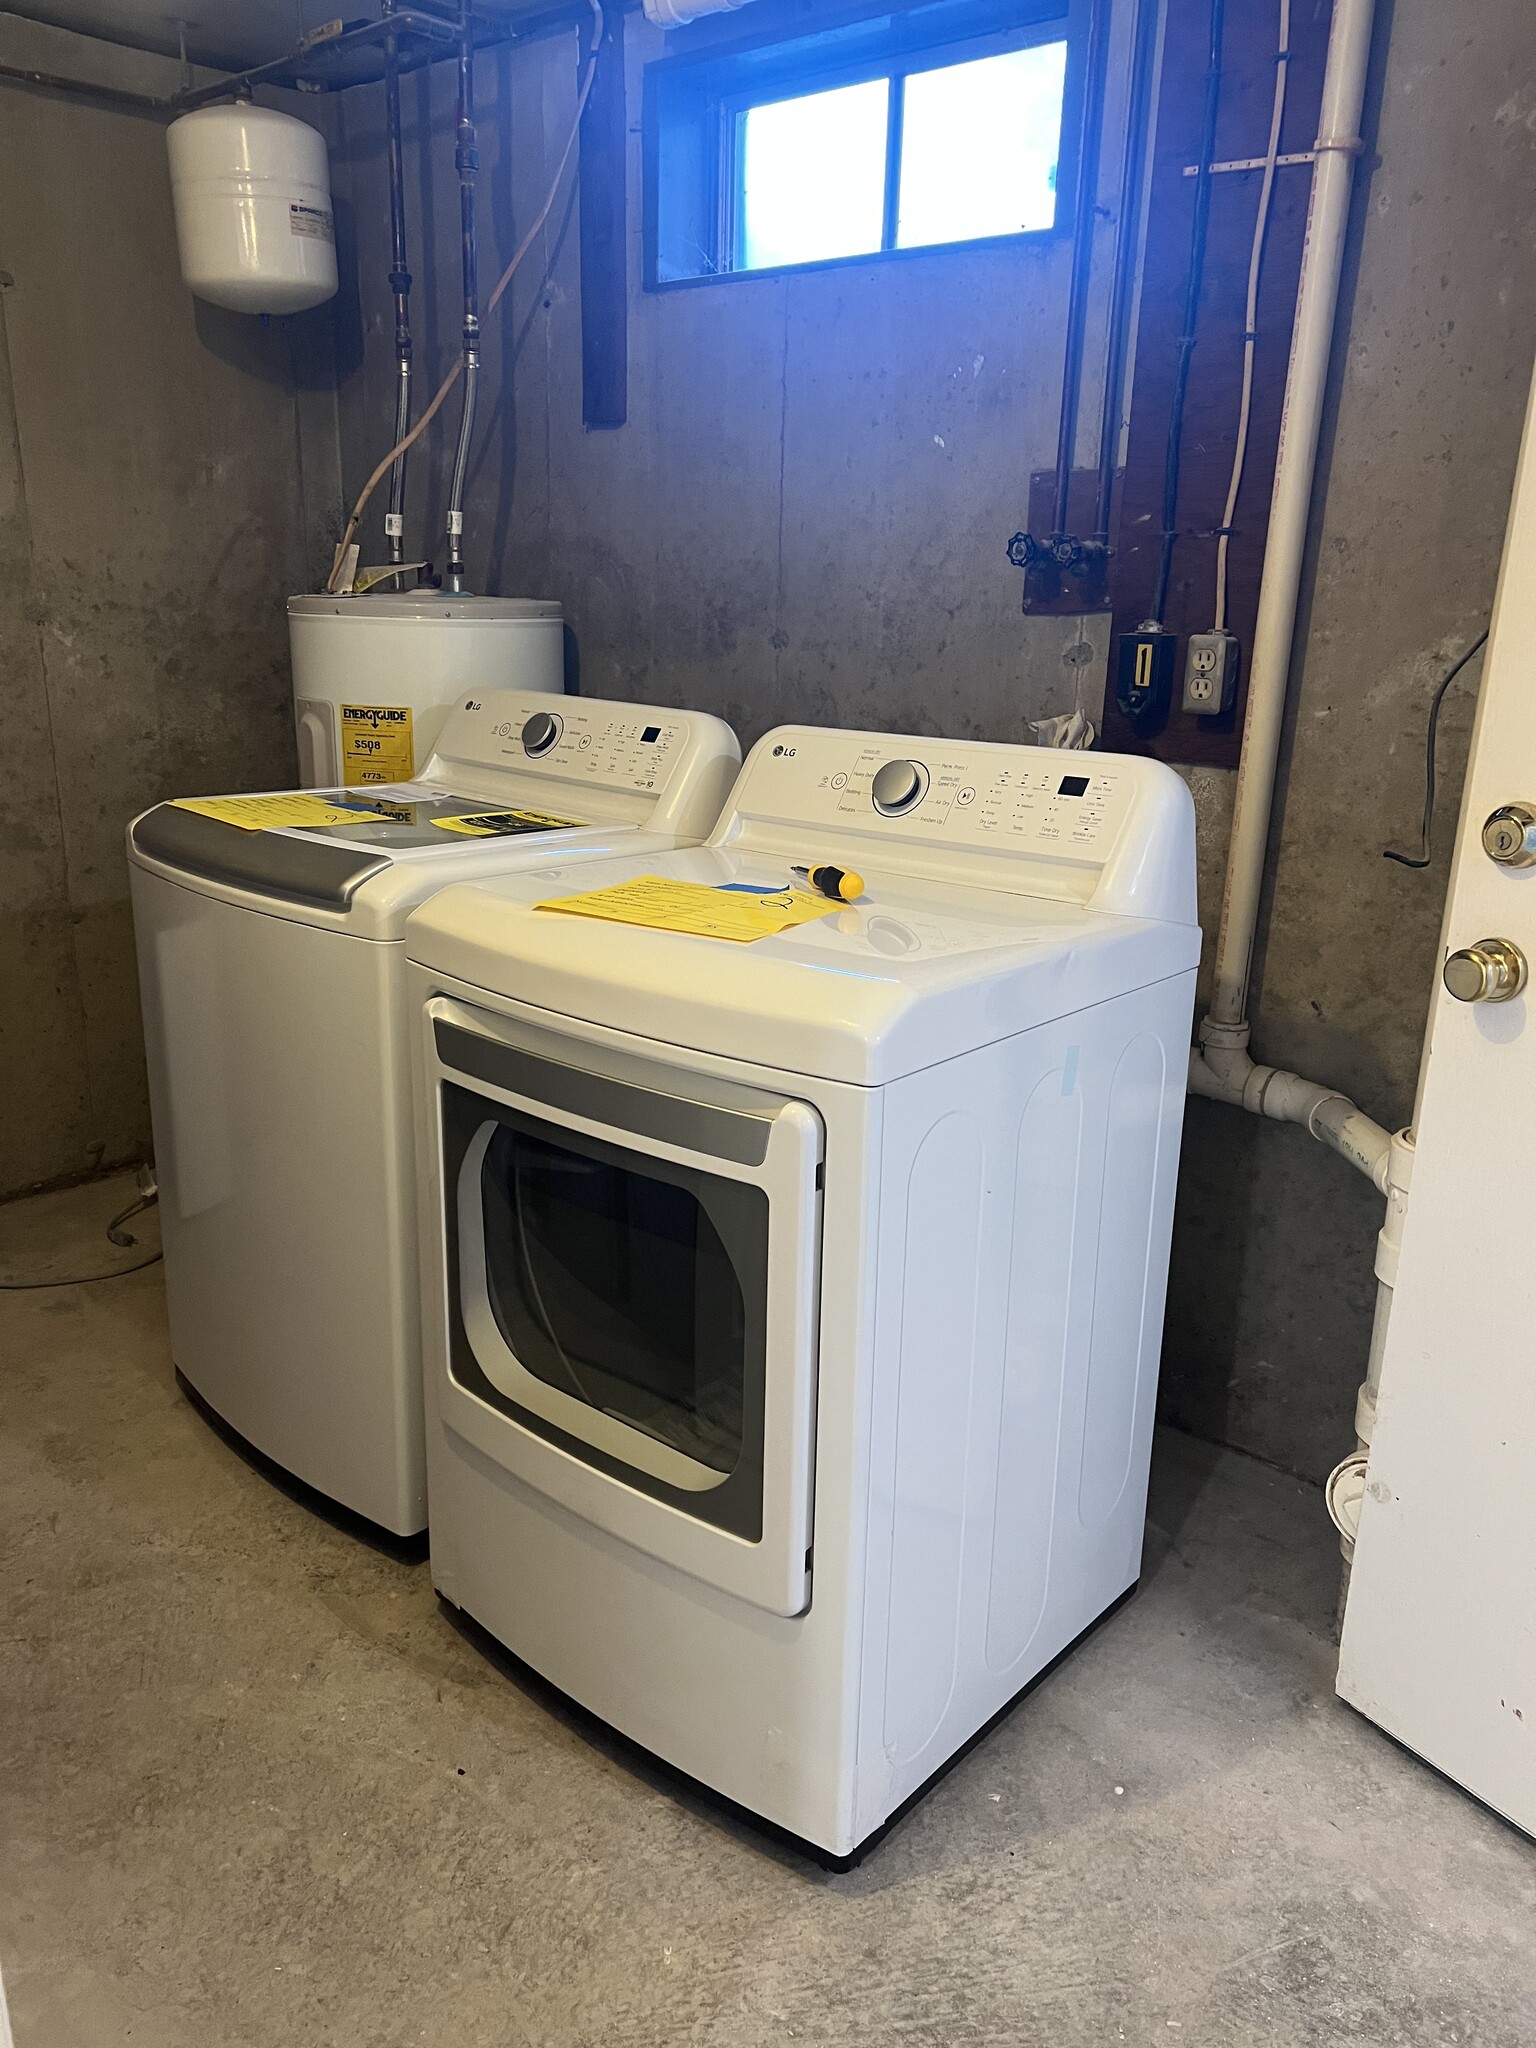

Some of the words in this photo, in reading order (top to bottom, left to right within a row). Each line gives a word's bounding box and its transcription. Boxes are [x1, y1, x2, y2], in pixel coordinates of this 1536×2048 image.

[1139, 647, 1148, 684] 1
[343, 708, 407, 722] ENERGYGUIDE
[354, 740, 381, 750] $508
[361, 772, 381, 782] 4773
